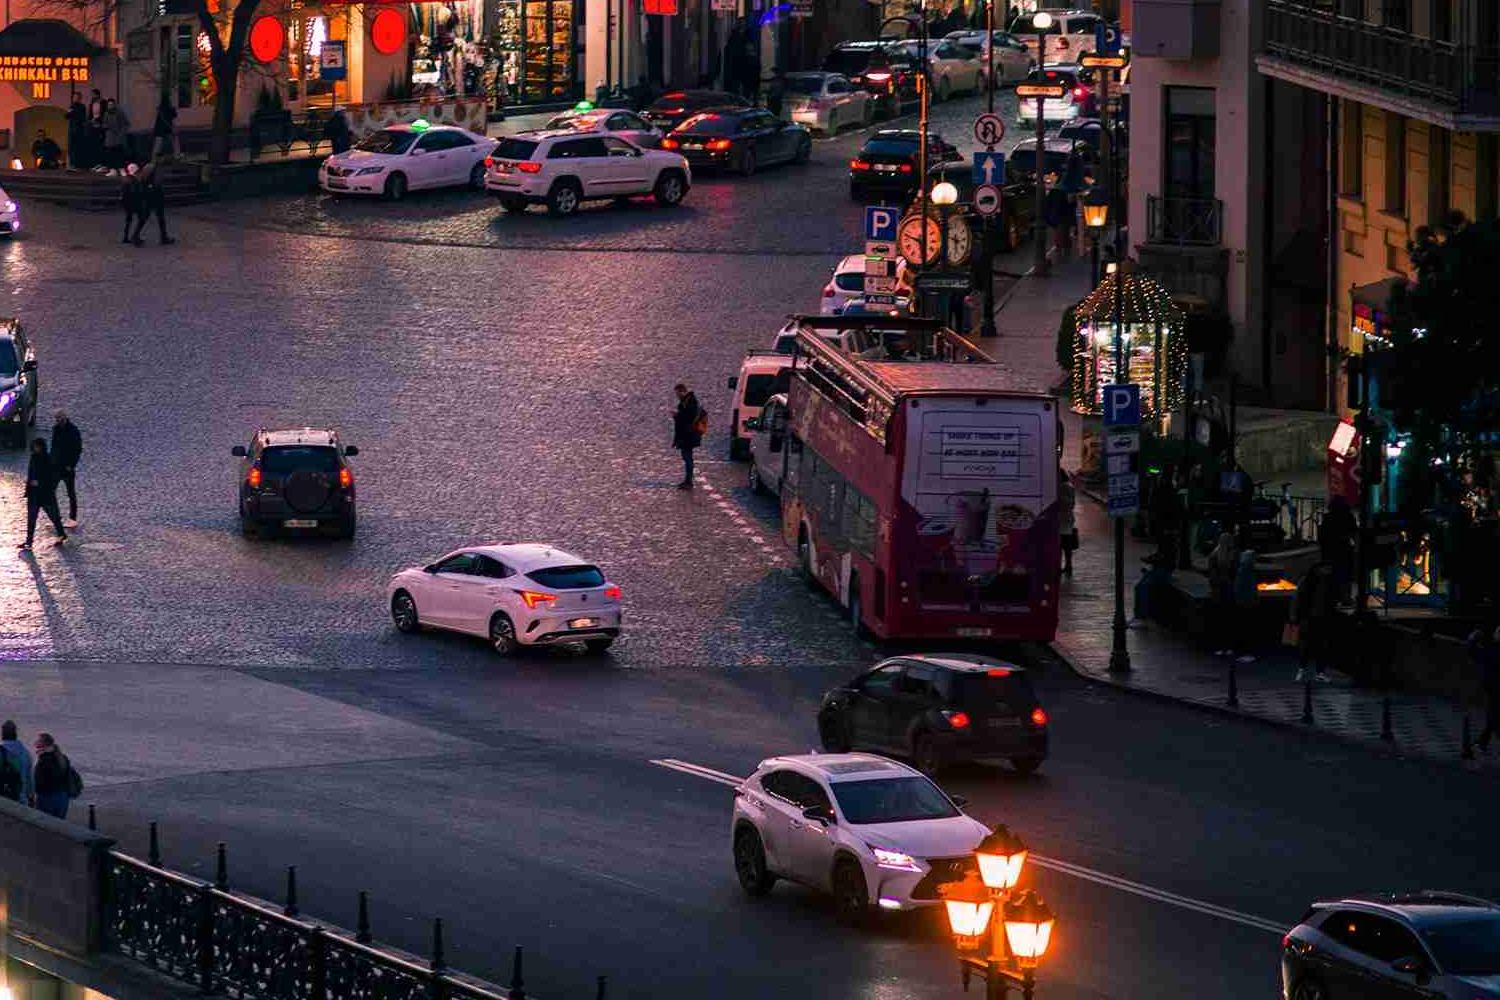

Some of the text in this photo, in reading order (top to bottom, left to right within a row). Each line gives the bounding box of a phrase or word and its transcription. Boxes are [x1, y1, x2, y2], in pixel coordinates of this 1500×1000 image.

[61, 67, 88, 81] BAR
[872, 210, 891, 238] P
[1111, 389, 1132, 421] P
